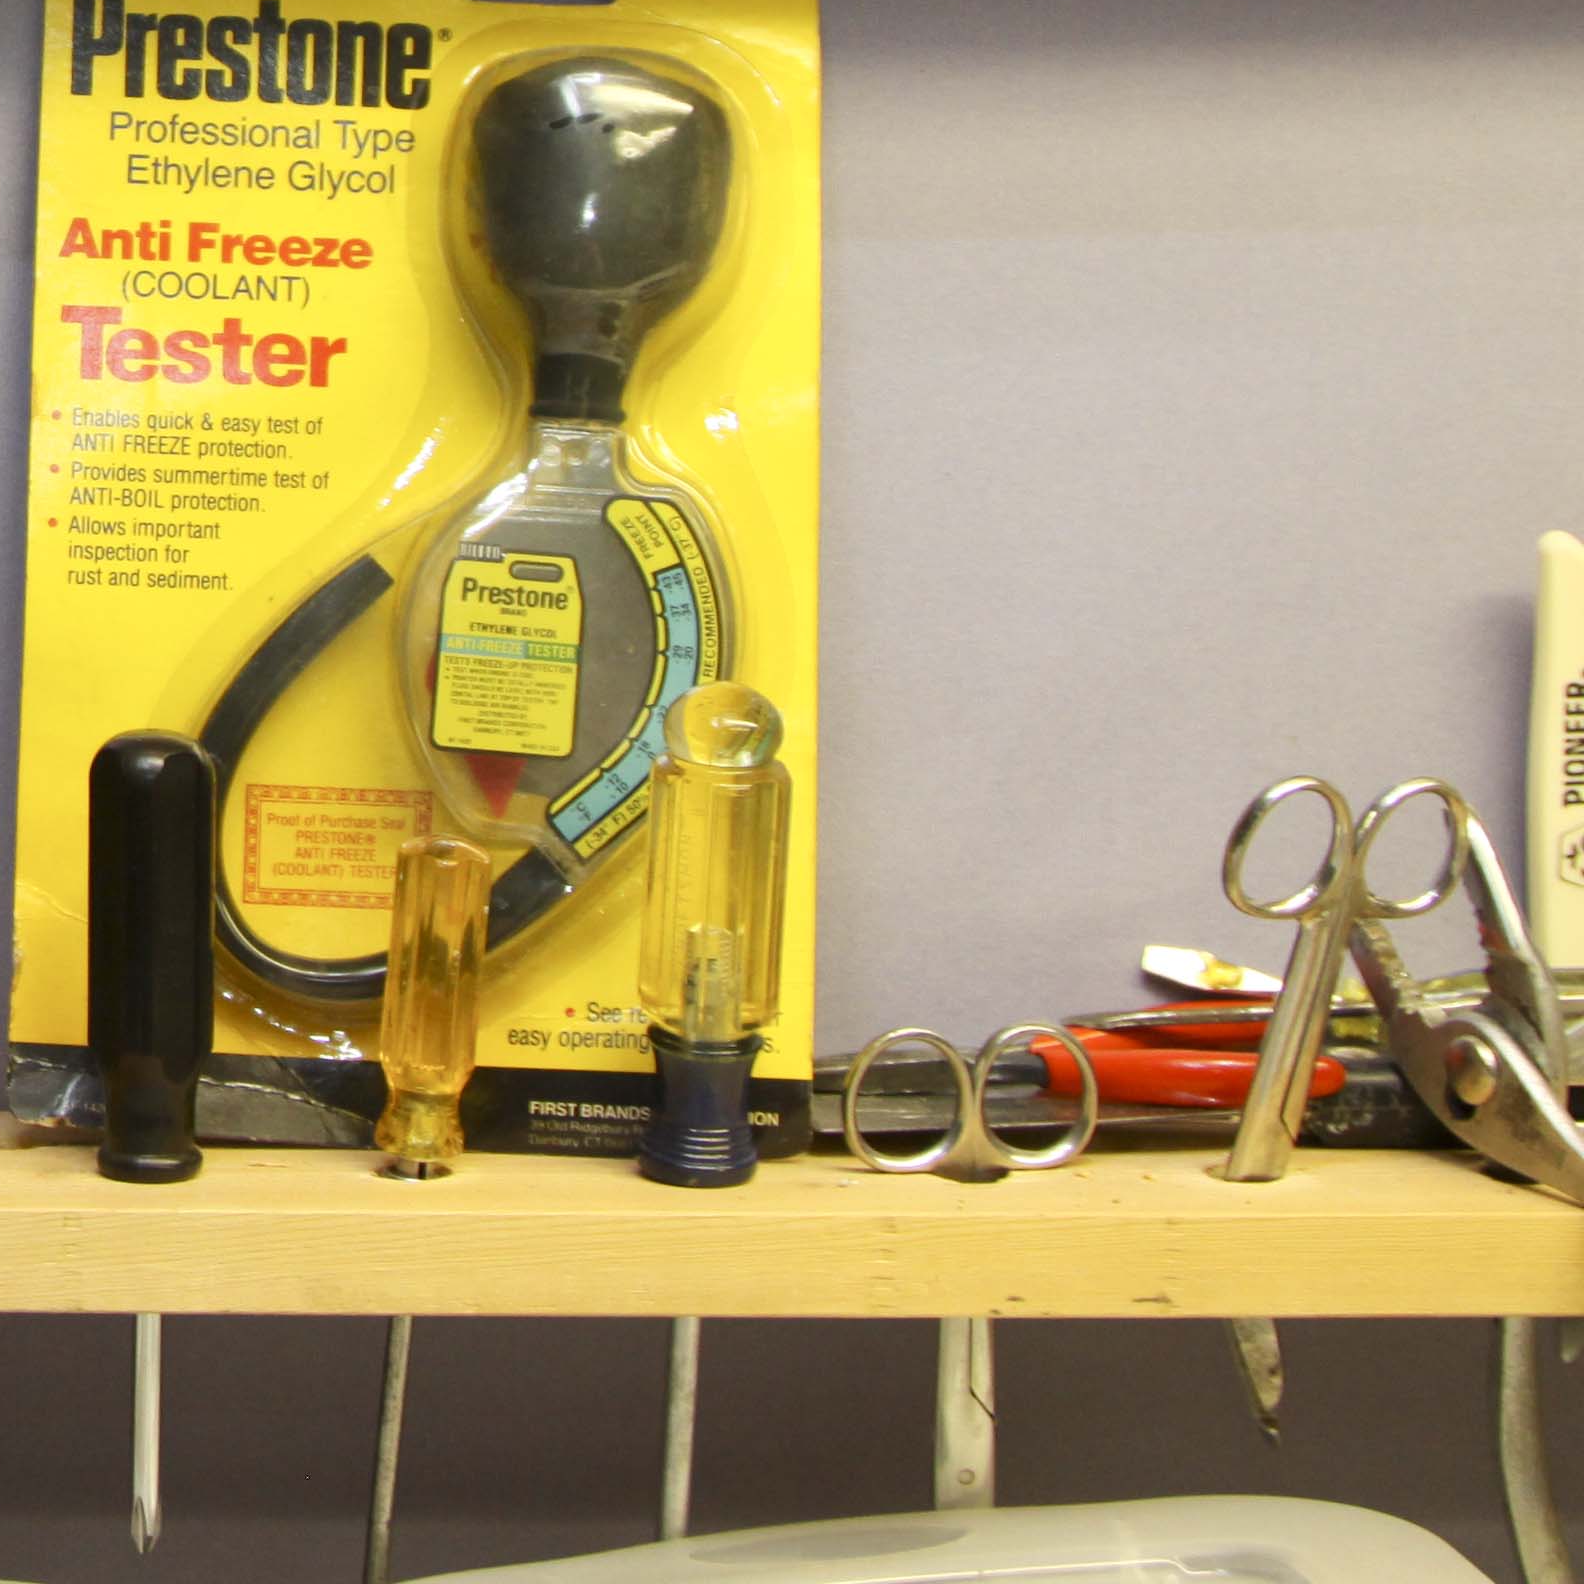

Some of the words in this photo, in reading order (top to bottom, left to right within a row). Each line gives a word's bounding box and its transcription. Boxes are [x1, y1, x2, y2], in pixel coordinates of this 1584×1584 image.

[110, 111, 321, 150] Professional
[332, 119, 416, 157] Type
[127, 154, 275, 194] Ethylene
[287, 160, 395, 200] Glycol
[58, 217, 172, 262] Anti
[187, 222, 374, 270] Freeze
[122, 270, 310, 309] (COOLANT)
[60, 304, 348, 388] Tester
[72, 407, 140, 429] Enables
[147, 411, 194, 431] quick
[201, 413, 214, 431] &
[221, 416, 260, 436] easy
[267, 415, 300, 434] test
[305, 416, 324, 435] of
[71, 433, 115, 452] ANTI
[123, 435, 191, 456] FREEZE
[198, 439, 293, 460] protection.
[71, 461, 146, 482] Provides
[153, 468, 268, 488] summertime
[274, 471, 306, 489] test
[312, 471, 330, 490] of
[69, 487, 163, 508] ANTI-BOIL
[170, 494, 267, 513] protection.
[68, 516, 126, 536] Allows
[133, 518, 221, 540] important
[620, 517, 653, 560] FREEZE
[634, 513, 664, 548] POINT
[68, 542, 158, 564] inspection
[164, 544, 190, 563] for
[68, 570, 102, 585] rust
[108, 570, 140, 586] and
[146, 570, 233, 591] sediment.
[460, 576, 569, 611] Prestone
[469, 622, 521, 636] ETHYLENE
[521, 626, 557, 639] GLYCOL
[693, 565, 719, 678] RECOMMENDED
[527, 642, 576, 659] TESTER
[320, 815, 378, 830] Purchase
[295, 847, 324, 859] ANTI
[331, 849, 376, 862] FREEZE
[272, 863, 344, 880] (COOLANT)
[586, 1001, 622, 1023] See
[508, 1027, 550, 1048] easy
[558, 1026, 652, 1054] operating
[528, 1100, 578, 1117] FIRST
[581, 1103, 652, 1121] BRANDS
